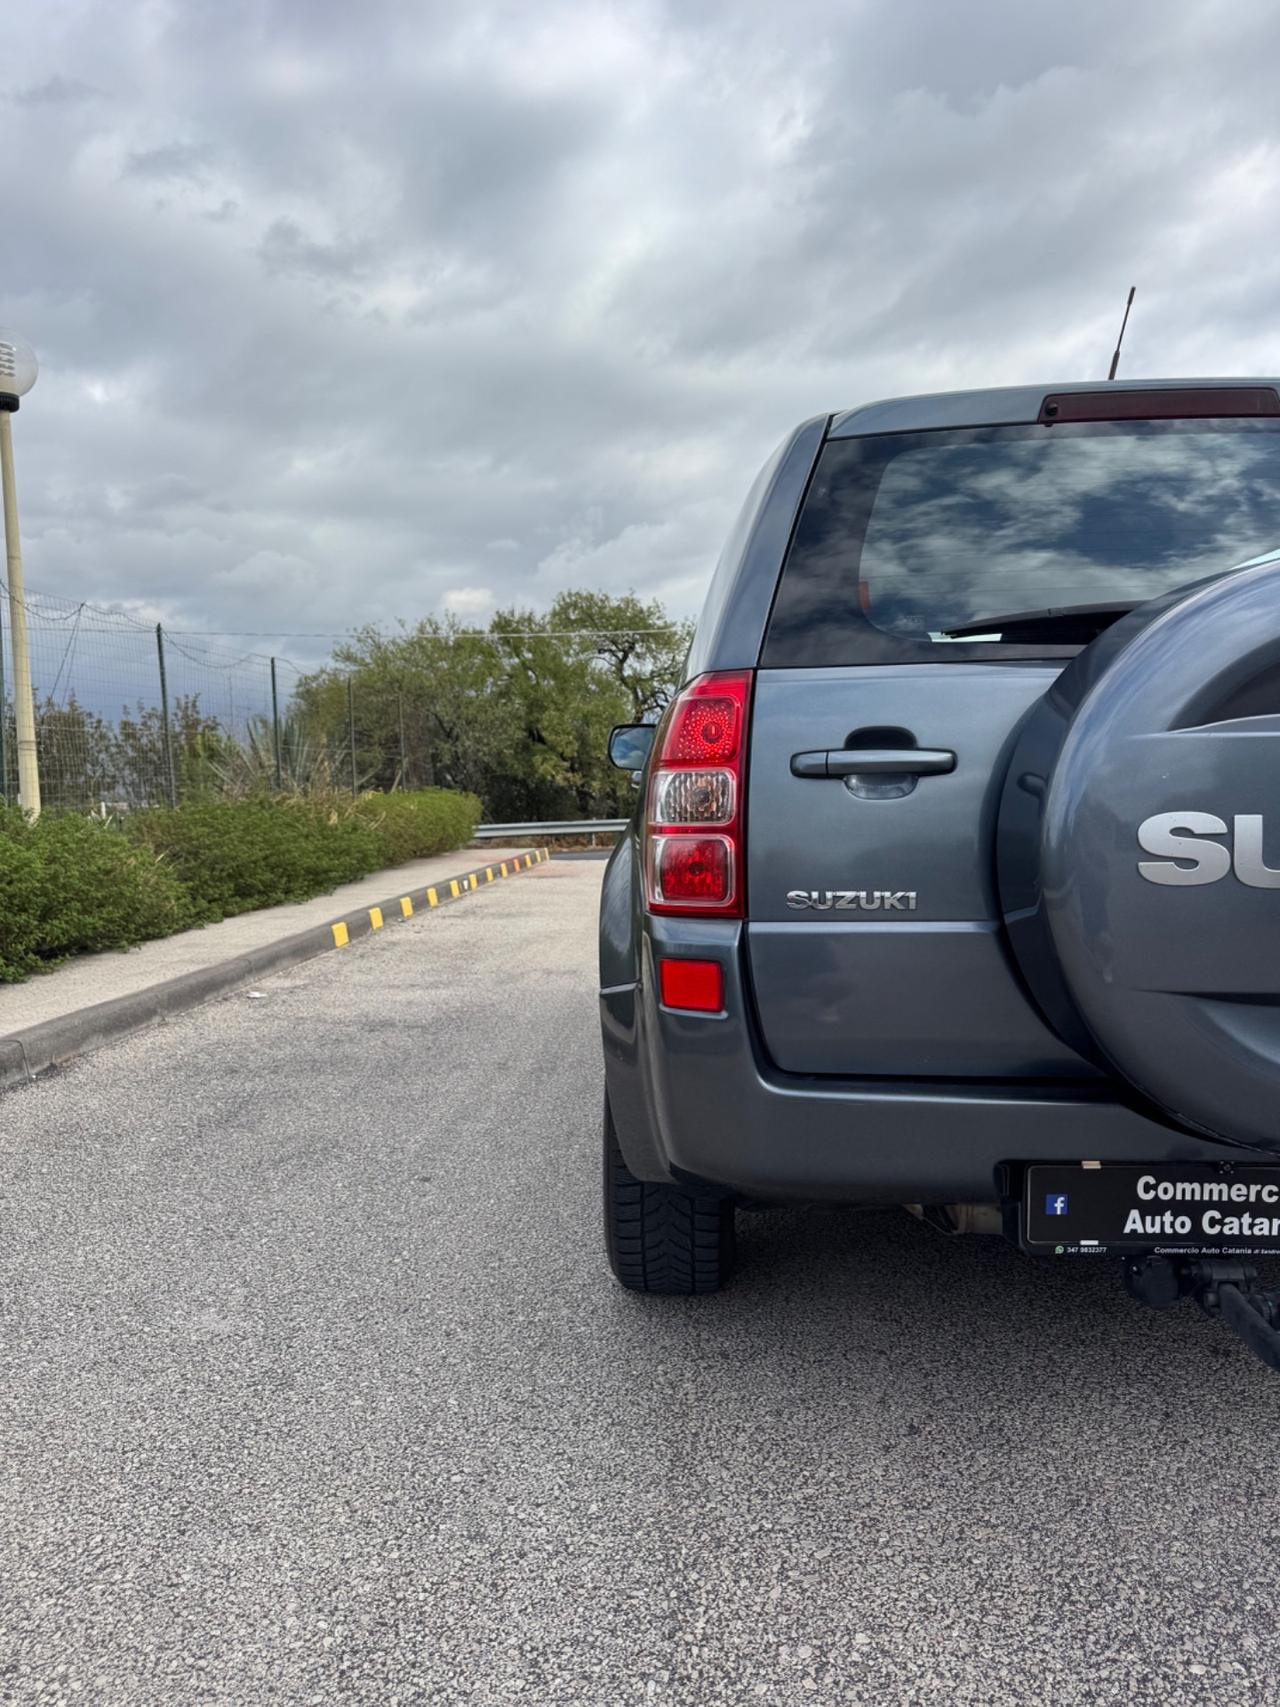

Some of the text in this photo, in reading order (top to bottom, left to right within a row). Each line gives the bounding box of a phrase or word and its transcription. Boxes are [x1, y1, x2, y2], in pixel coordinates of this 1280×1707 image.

[786, 890, 917, 910] SUZUKI
[1137, 1175, 1280, 1203] Commerc
[1123, 1209, 1192, 1234] Auto
